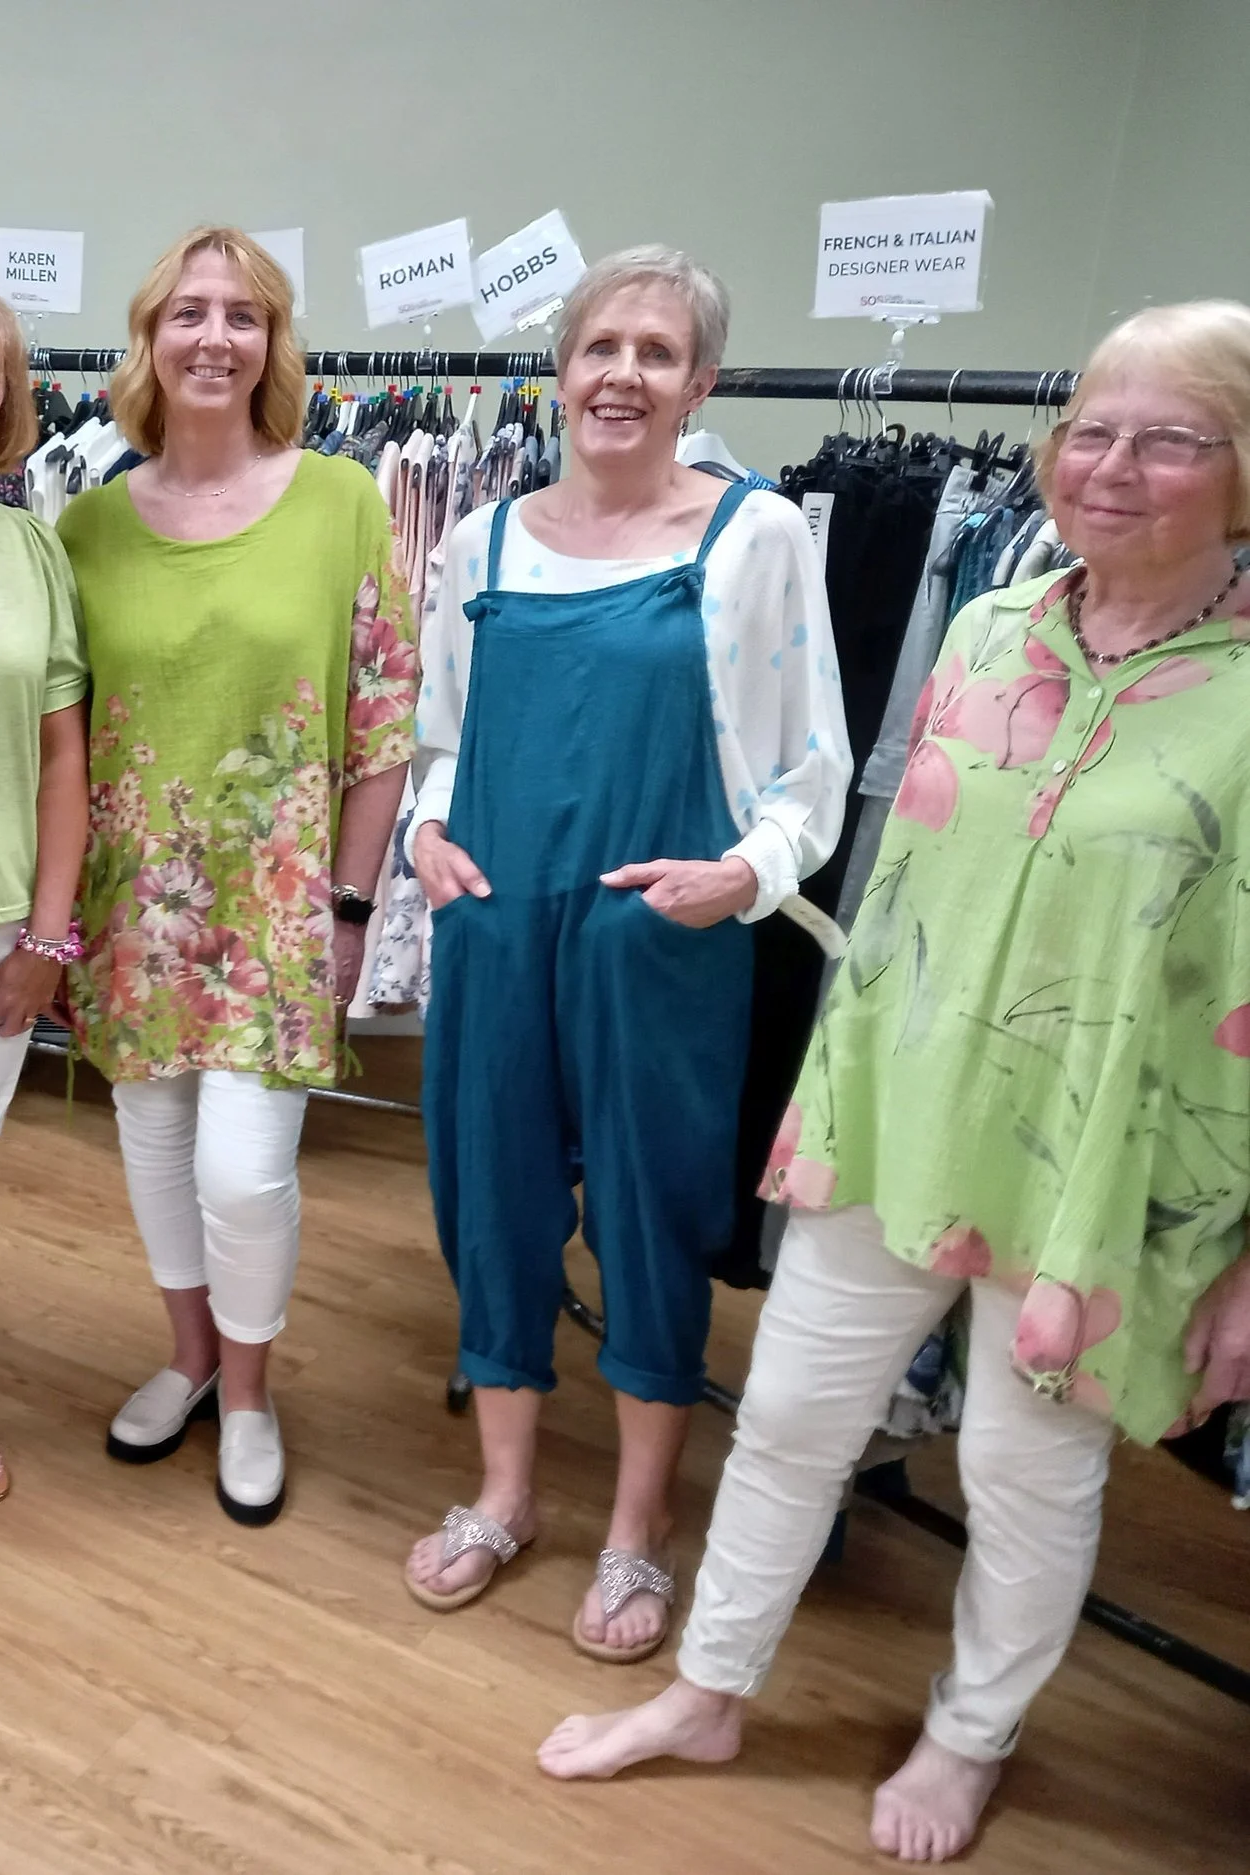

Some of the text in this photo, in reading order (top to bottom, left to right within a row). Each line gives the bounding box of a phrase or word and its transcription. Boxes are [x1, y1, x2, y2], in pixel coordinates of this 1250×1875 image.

[823, 228, 977, 252] FRENCH & ITALIAN
[8, 250, 56, 267] KAREN
[828, 256, 966, 277] DESIGNER WEAR
[5, 267, 57, 283] MILLEN
[379, 252, 455, 290] ROMAN
[480, 246, 558, 304] HOBBS
